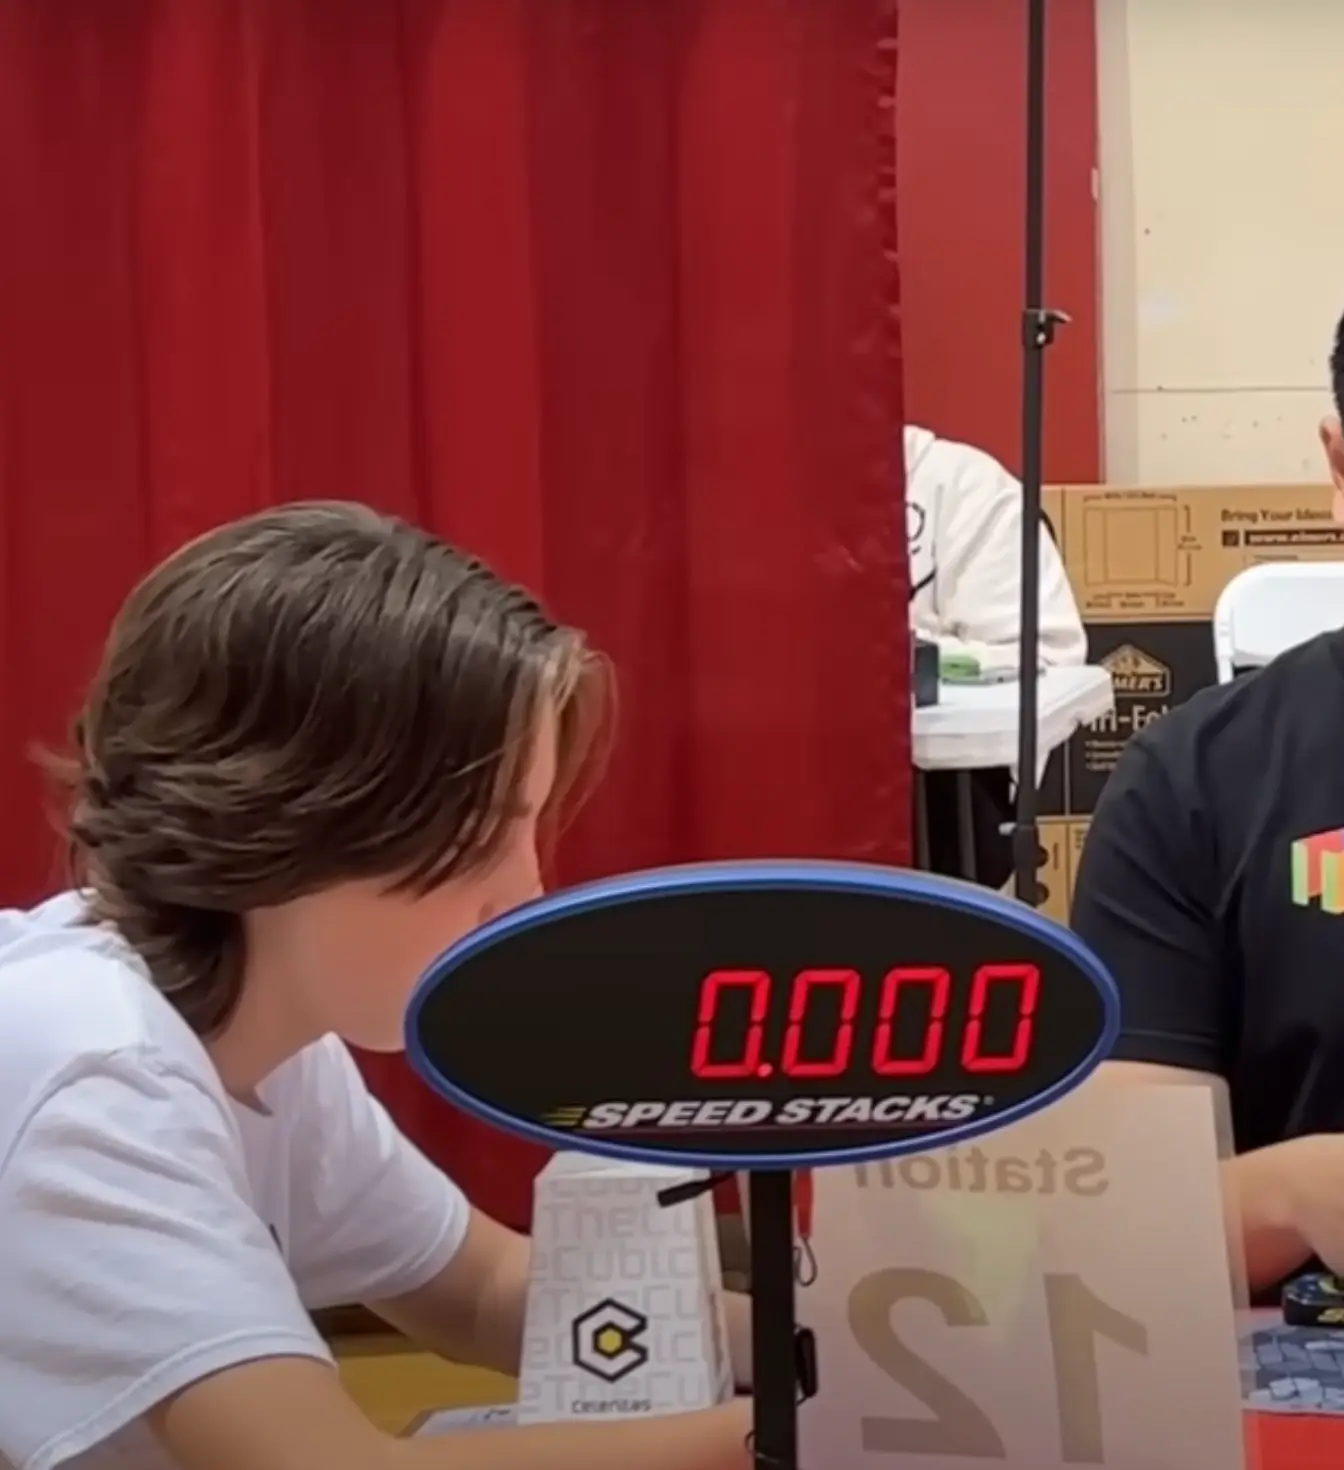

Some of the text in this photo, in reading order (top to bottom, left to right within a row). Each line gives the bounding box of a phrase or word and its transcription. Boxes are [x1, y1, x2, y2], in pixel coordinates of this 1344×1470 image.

[691, 964, 1040, 1078] 0.000
[582, 1094, 979, 1130] SPEED STACKS
